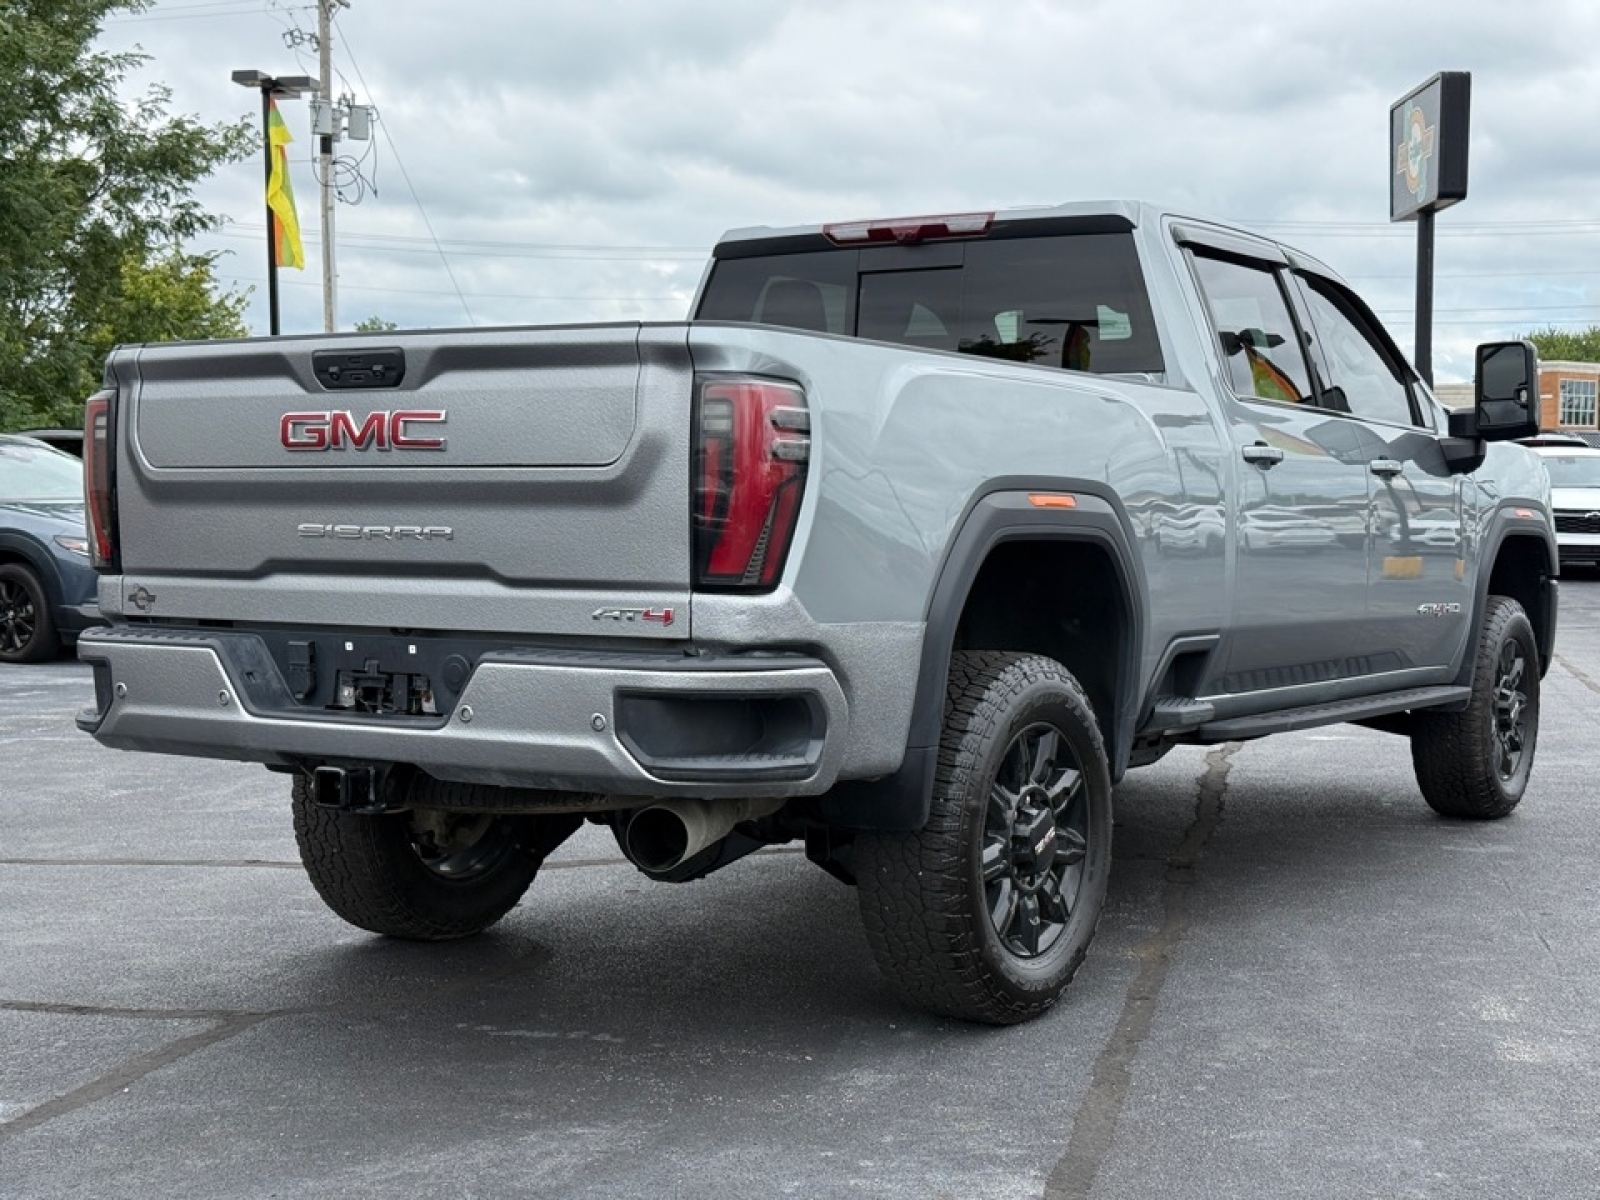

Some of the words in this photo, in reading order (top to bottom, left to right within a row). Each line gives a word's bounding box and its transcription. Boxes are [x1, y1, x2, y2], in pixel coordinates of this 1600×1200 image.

[280, 409, 447, 450] GMC
[297, 523, 453, 541] SIERRA
[592, 606, 675, 626] AT4
